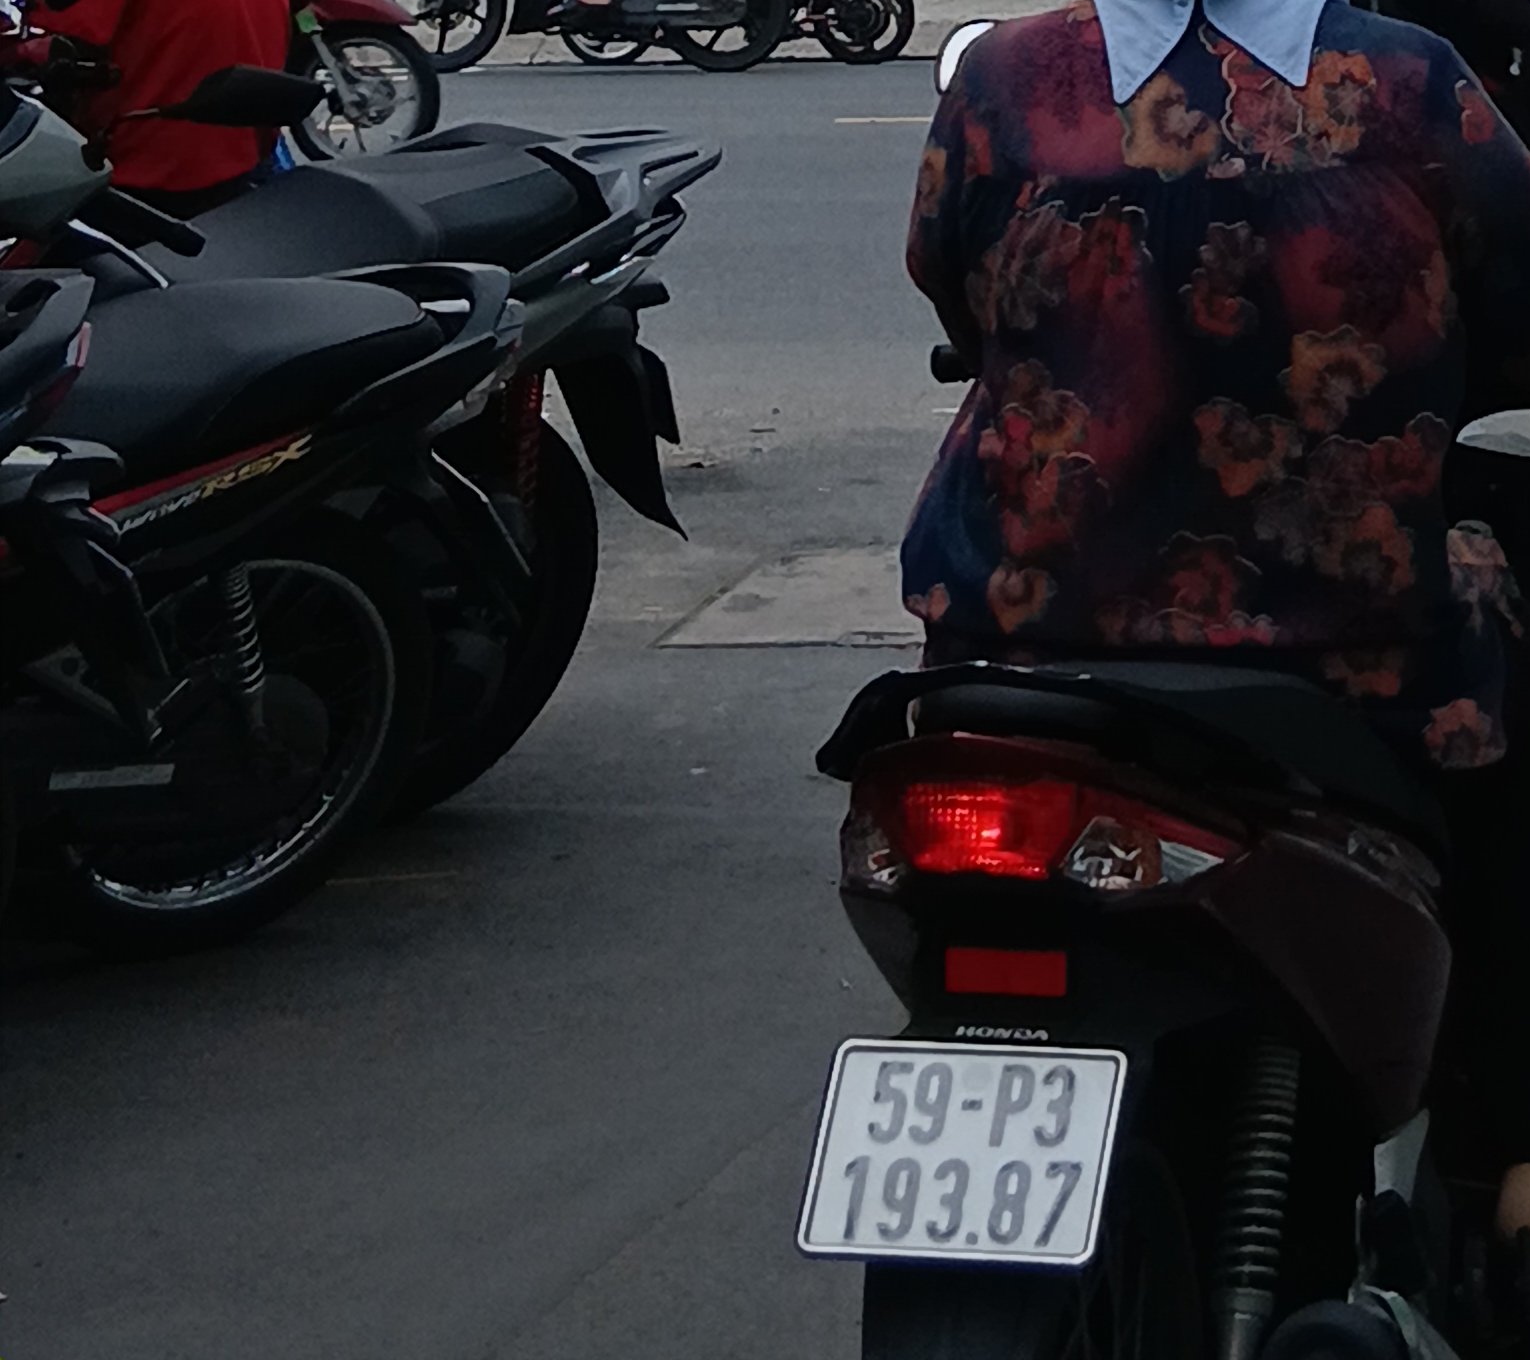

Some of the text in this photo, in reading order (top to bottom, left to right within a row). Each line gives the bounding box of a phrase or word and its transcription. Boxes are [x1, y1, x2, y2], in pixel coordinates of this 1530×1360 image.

[954, 1024, 1049, 1041] HONDA
[866, 1059, 1077, 1148] 59-P3
[842, 1154, 1083, 1249] 193.87
